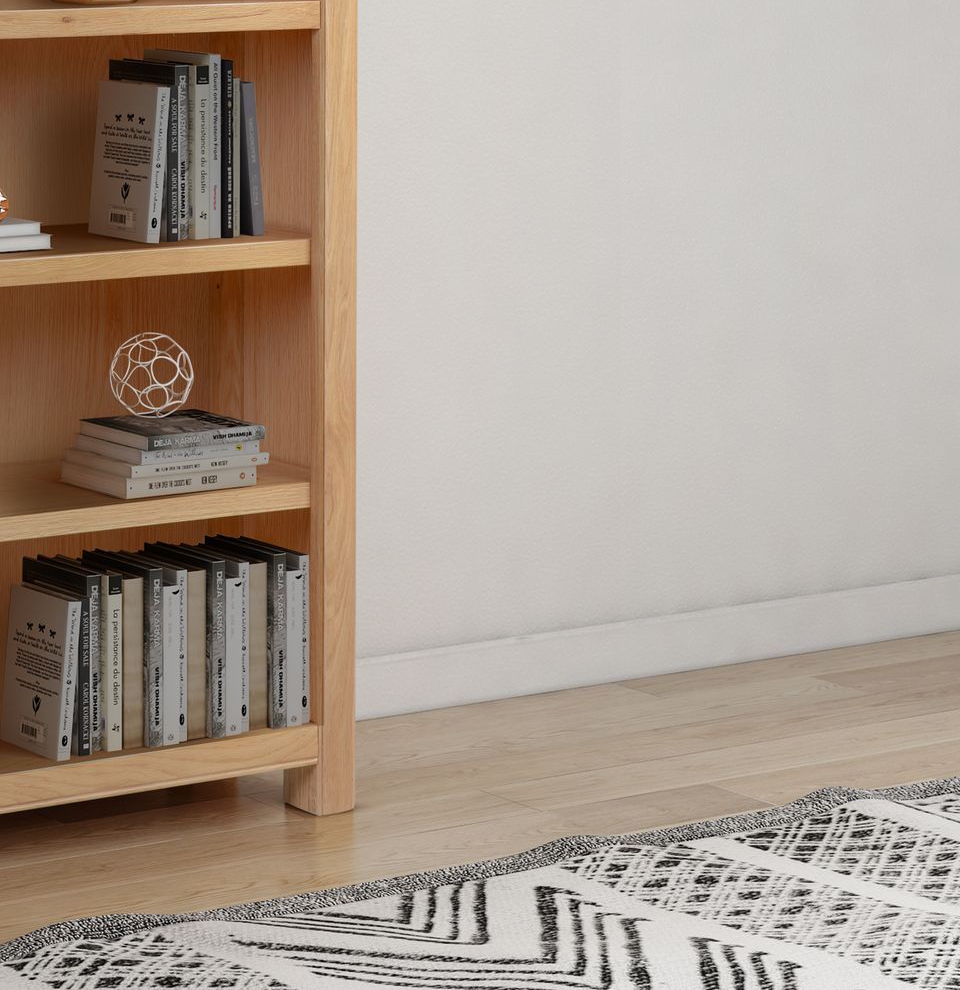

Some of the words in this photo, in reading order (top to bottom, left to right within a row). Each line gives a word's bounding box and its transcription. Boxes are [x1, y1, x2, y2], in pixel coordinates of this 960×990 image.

[213, 93, 218, 101] on
[199, 110, 207, 155] persistance
[200, 156, 208, 168] du
[200, 170, 208, 194] destin
[111, 621, 120, 666] persistance
[113, 668, 121, 680] du
[113, 681, 121, 706] destin
